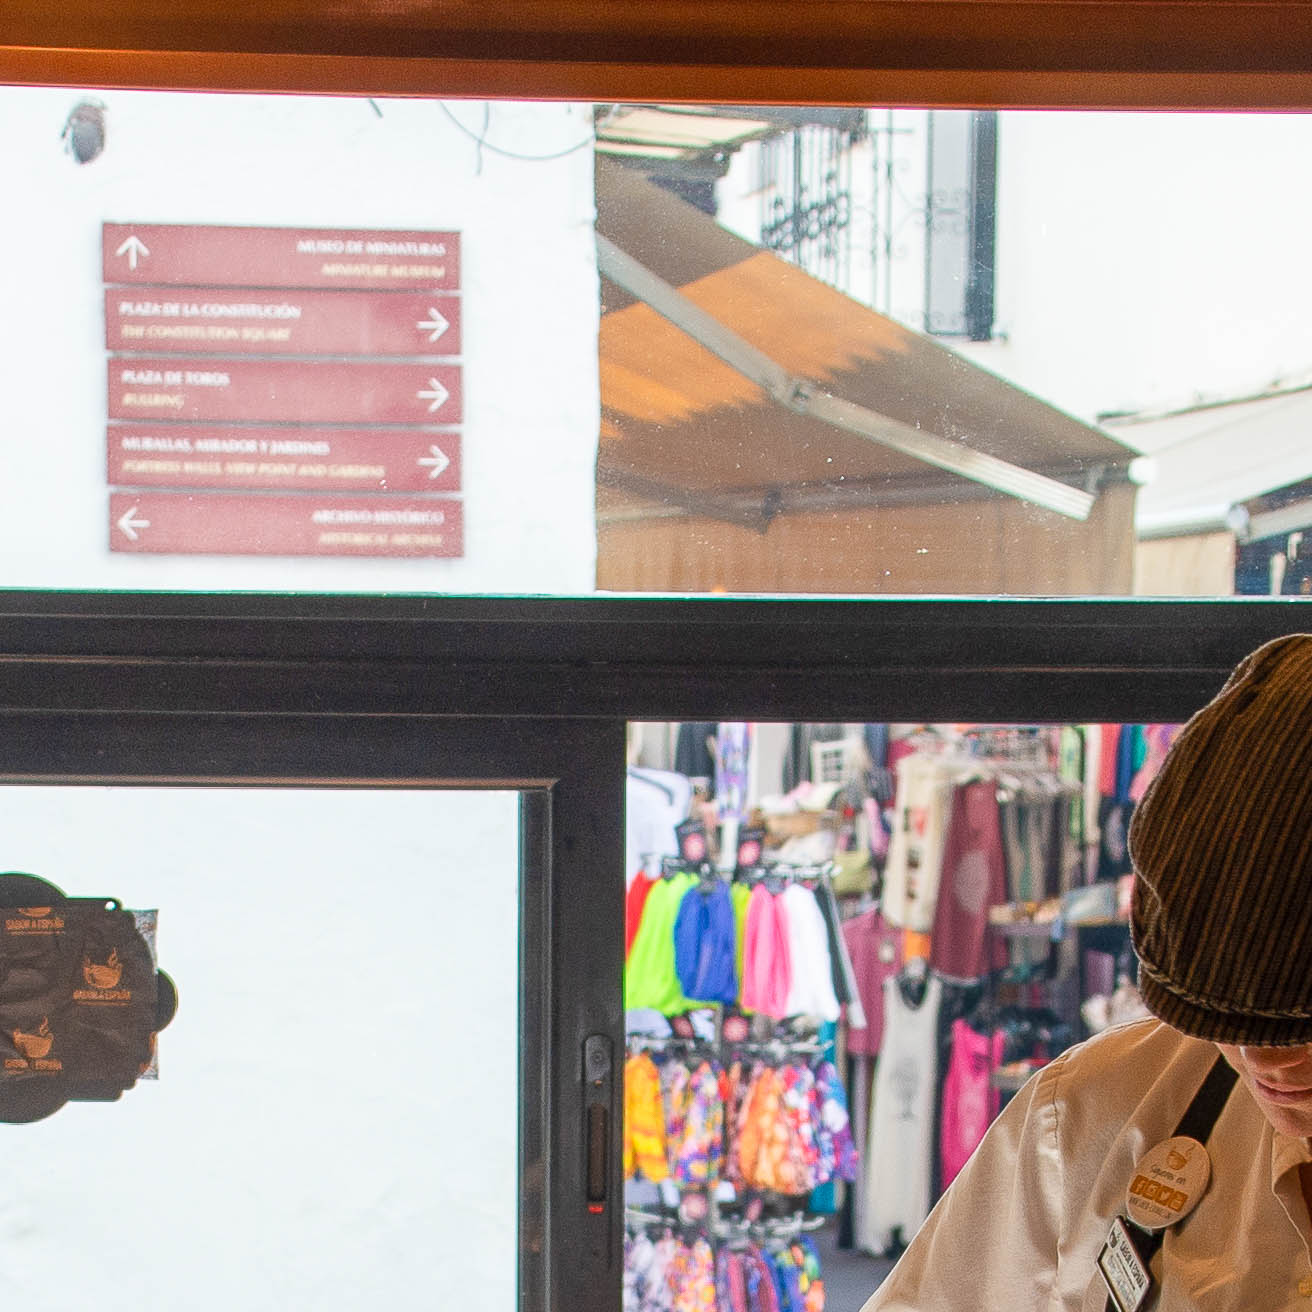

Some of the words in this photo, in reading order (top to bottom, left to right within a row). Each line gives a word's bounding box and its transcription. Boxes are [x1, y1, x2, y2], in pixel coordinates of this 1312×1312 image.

[345, 240, 363, 254] DE
[119, 302, 162, 317] PLAZA
[163, 303, 180, 317] DE
[183, 303, 199, 317] LA
[121, 370, 162, 384] PLAZA
[164, 370, 183, 385] DE
[185, 371, 230, 386] TOROS
